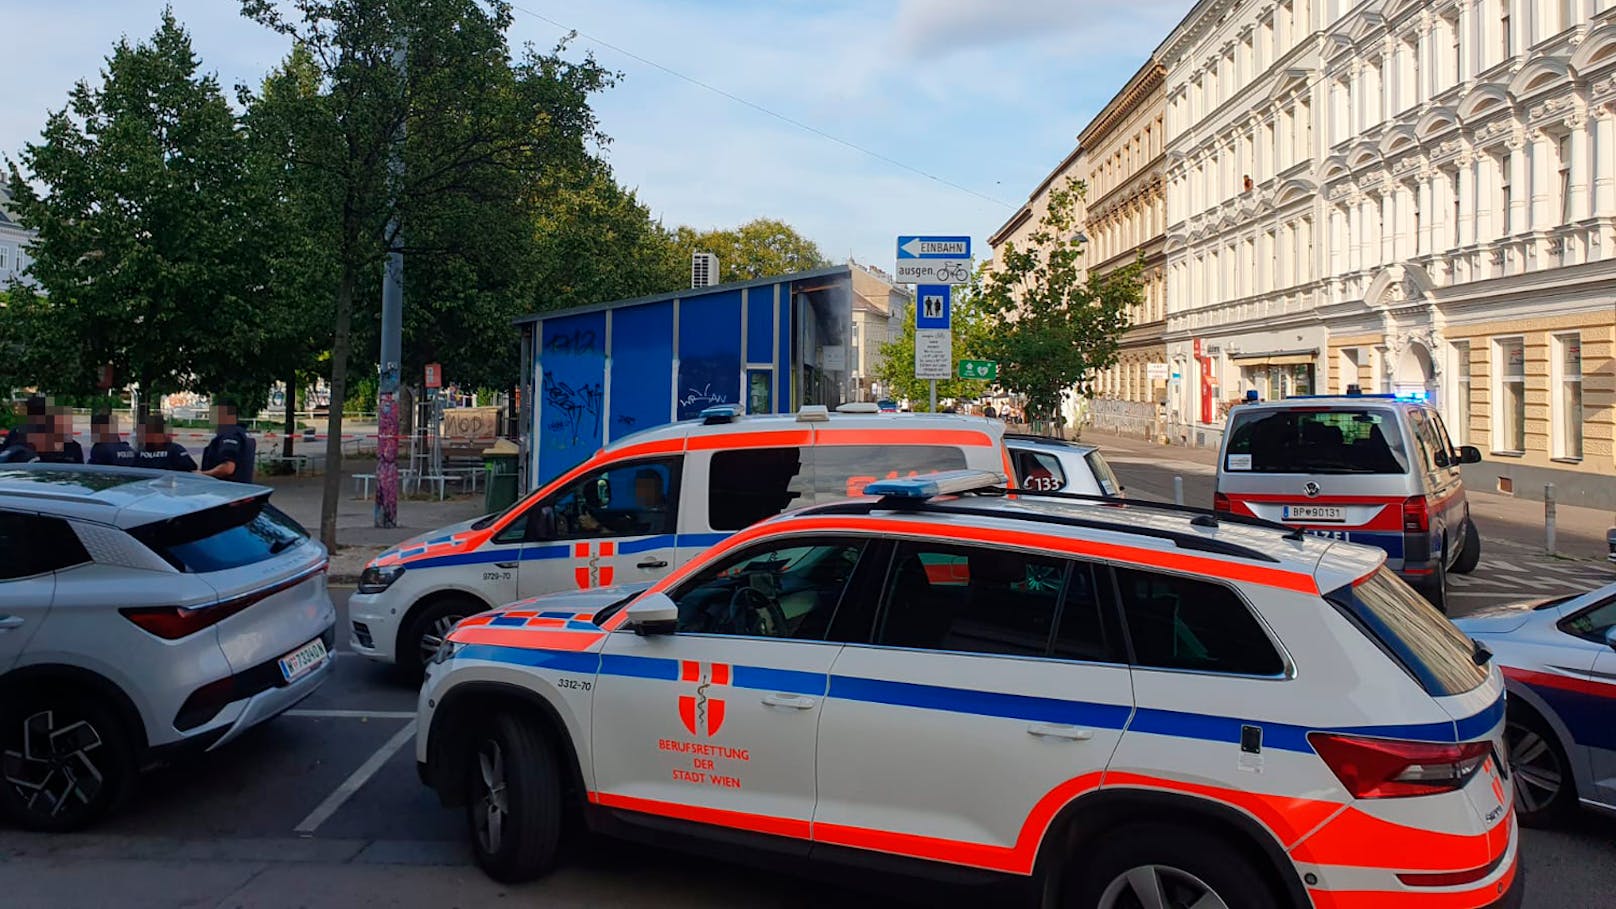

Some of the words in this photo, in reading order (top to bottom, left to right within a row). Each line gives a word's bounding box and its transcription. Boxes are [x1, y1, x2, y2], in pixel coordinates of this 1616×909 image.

[921, 243, 963, 252] EINBAHN
[898, 267, 936, 278] ausgen.
[140, 451, 168, 459] POLIZEI
[1035, 477, 1060, 491] 133
[1293, 507, 1305, 517] BP
[1312, 508, 1340, 517] 90131
[558, 678, 592, 692] 3312-70
[659, 739, 750, 761] BERUFSRETTUNG
[694, 758, 714, 770] DER
[673, 770, 706, 784] STADT
[710, 774, 741, 788] WIEN
